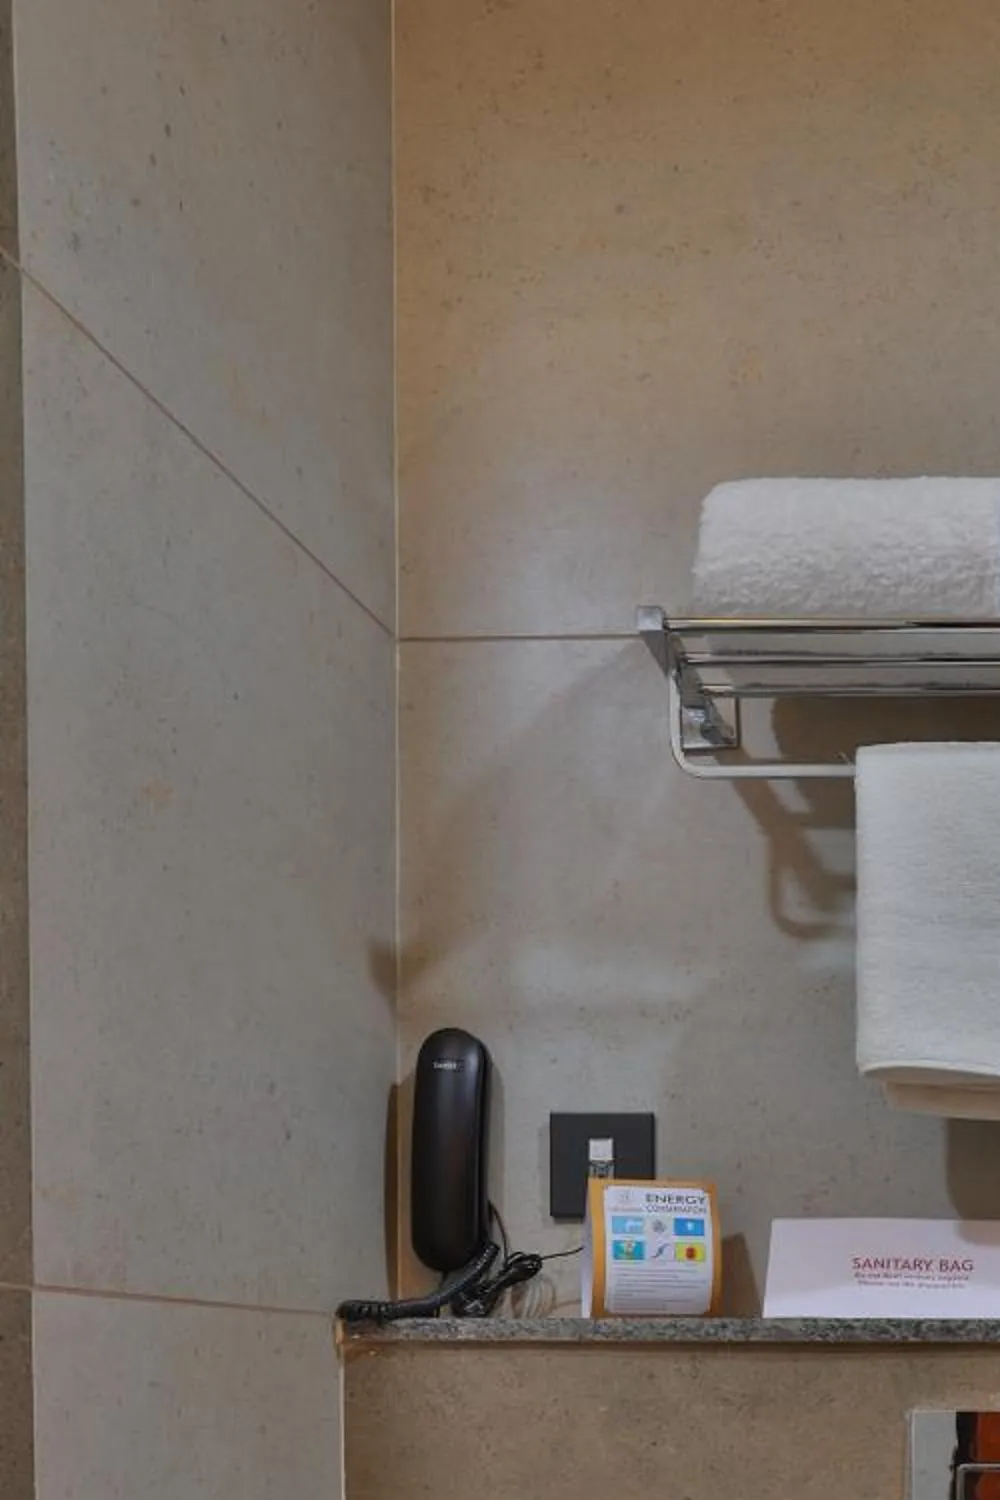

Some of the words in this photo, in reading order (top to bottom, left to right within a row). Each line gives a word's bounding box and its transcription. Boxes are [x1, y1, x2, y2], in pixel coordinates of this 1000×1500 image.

[645, 1193, 705, 1205] ENERGY
[852, 1257, 933, 1271] SANITARY
[939, 1258, 974, 1273] BAG
